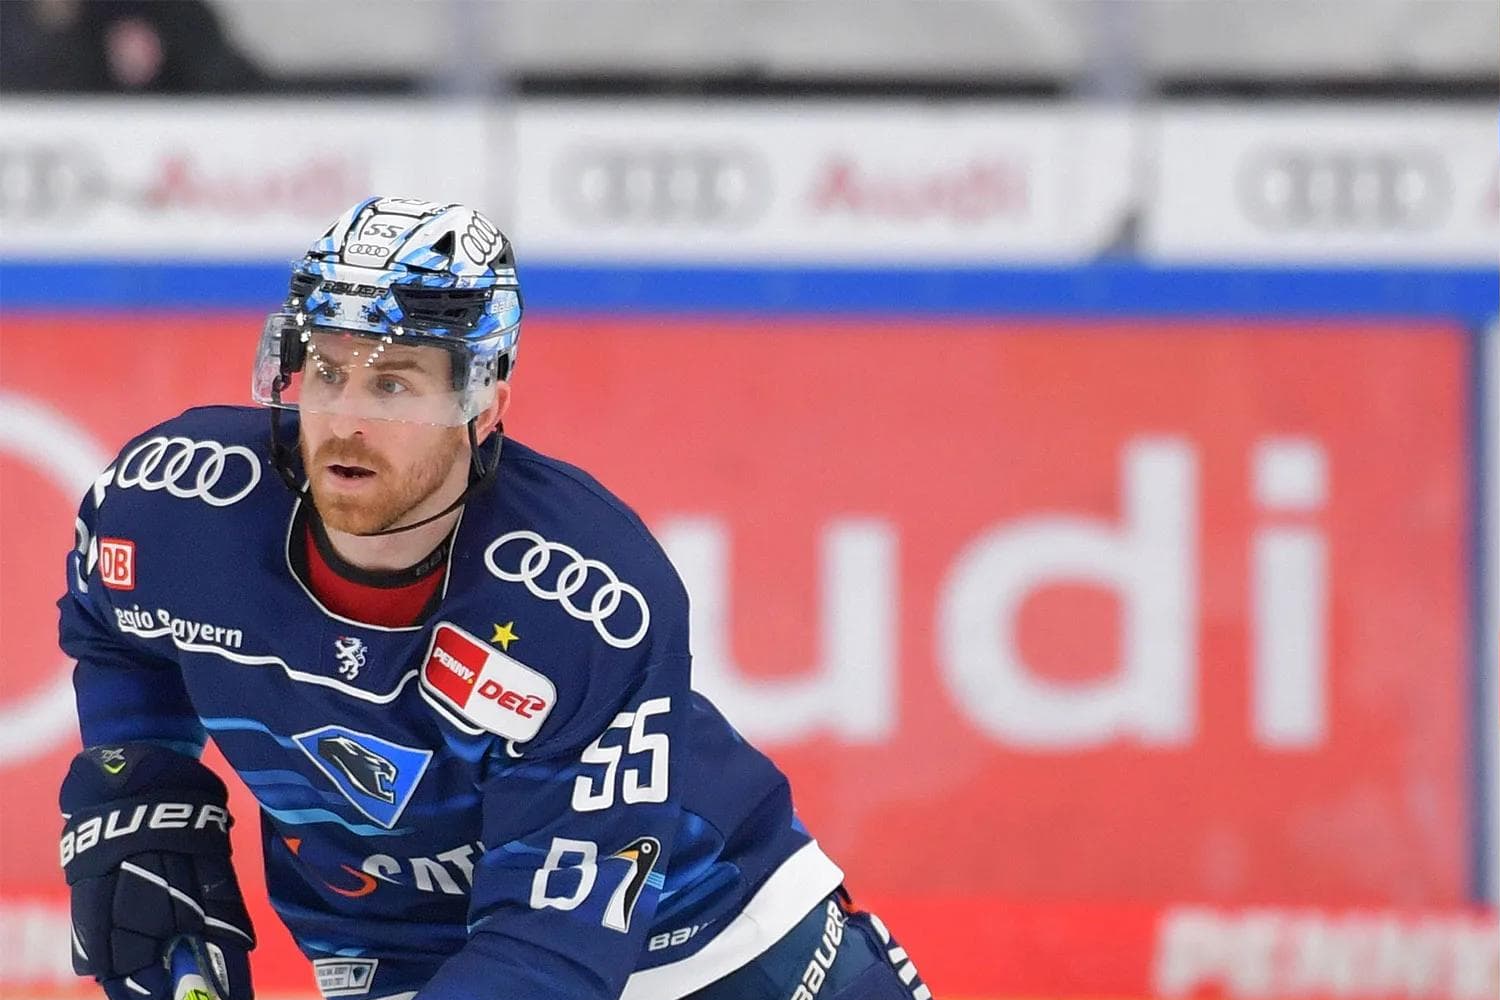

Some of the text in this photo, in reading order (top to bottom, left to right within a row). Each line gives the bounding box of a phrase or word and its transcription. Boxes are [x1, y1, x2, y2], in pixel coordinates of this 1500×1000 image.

[363, 222, 404, 239] 55
[318, 280, 390, 299] BAUER
[101, 546, 130, 581] DB
[658, 432, 1332, 750] udi
[114, 603, 154, 631] egio
[571, 696, 671, 813] 55
[59, 803, 228, 869] BAUER
